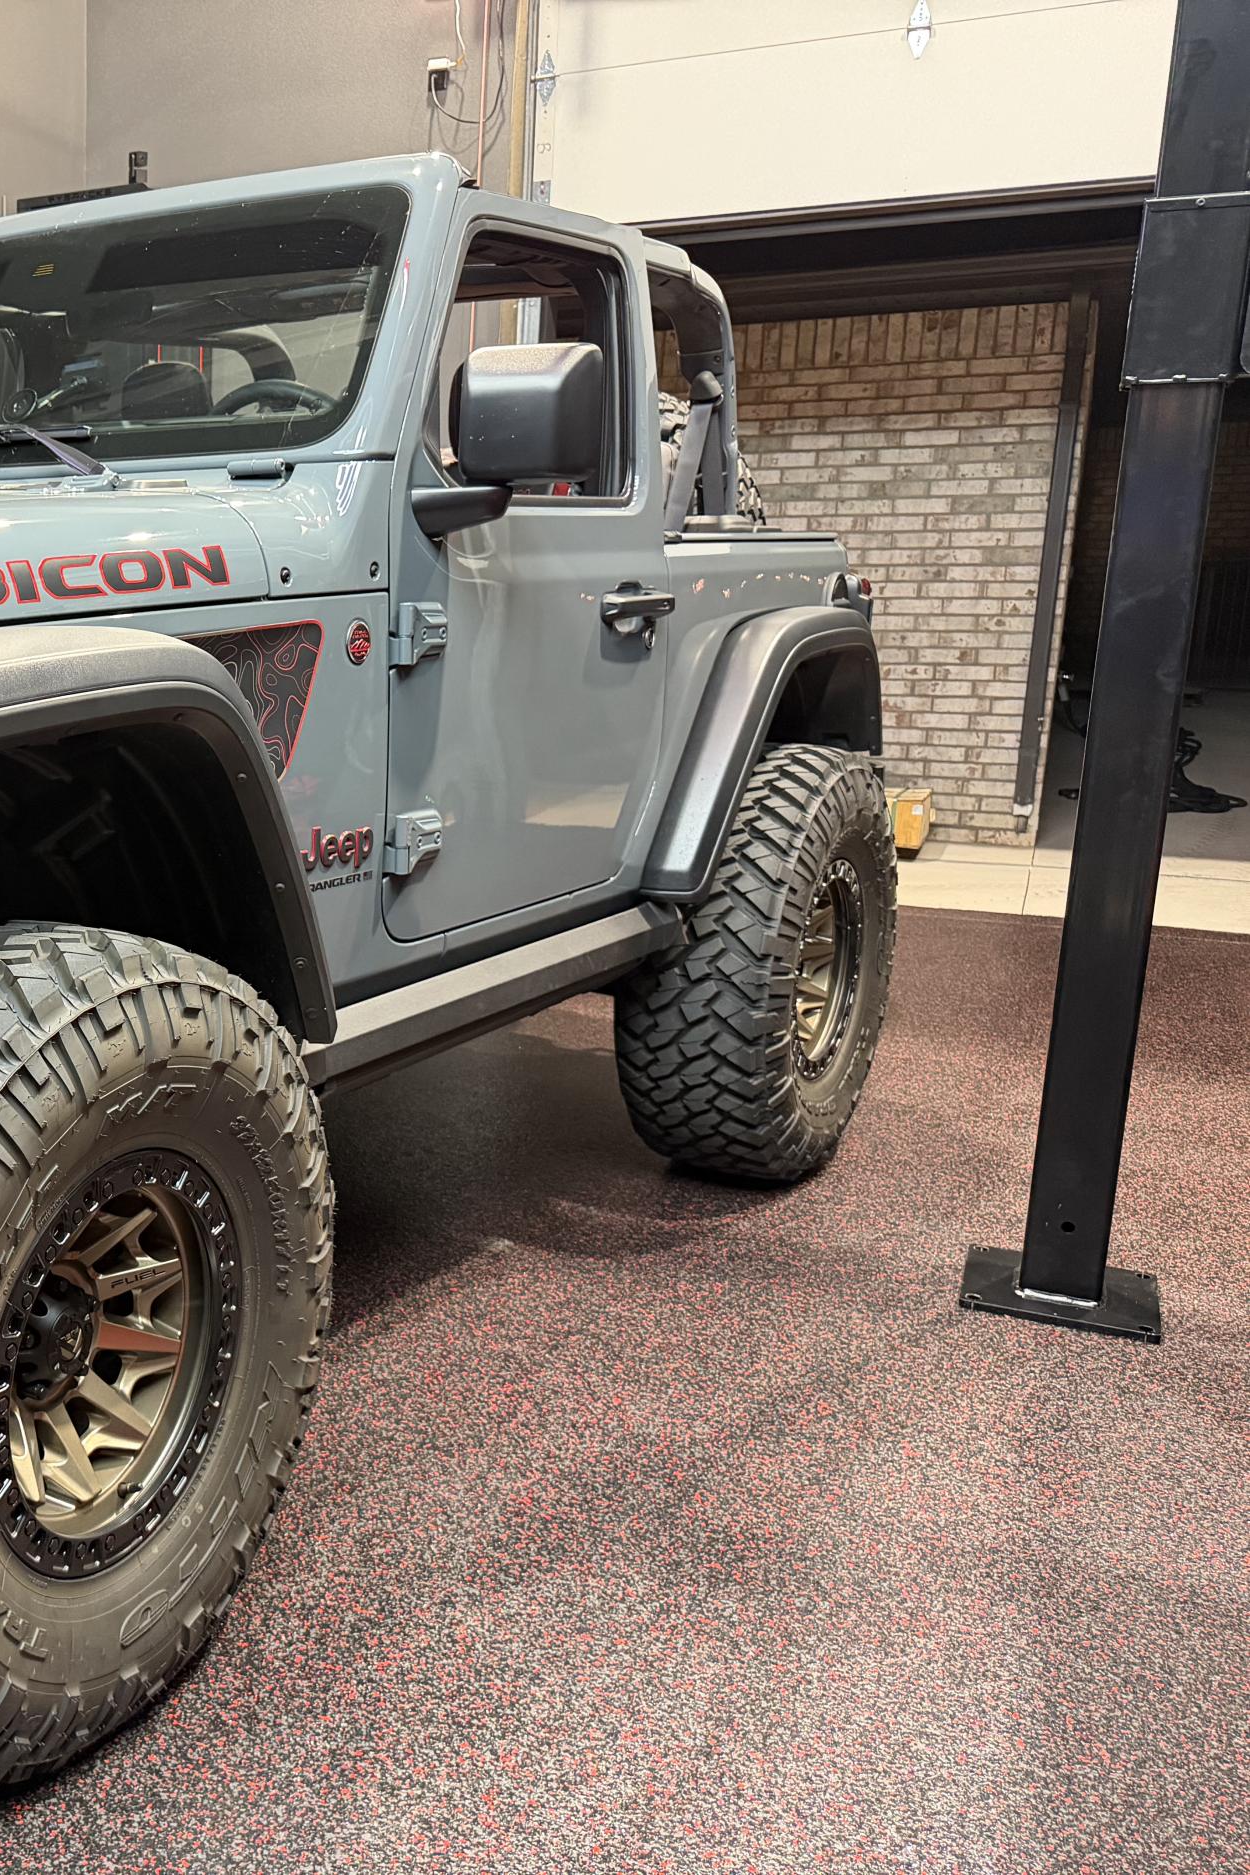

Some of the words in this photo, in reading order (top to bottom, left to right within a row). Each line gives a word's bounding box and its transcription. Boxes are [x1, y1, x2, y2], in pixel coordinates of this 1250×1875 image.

[300, 826, 374, 872] Jeep
[309, 873, 361, 892] RANGLER
[110, 1268, 166, 1289] FUEL
